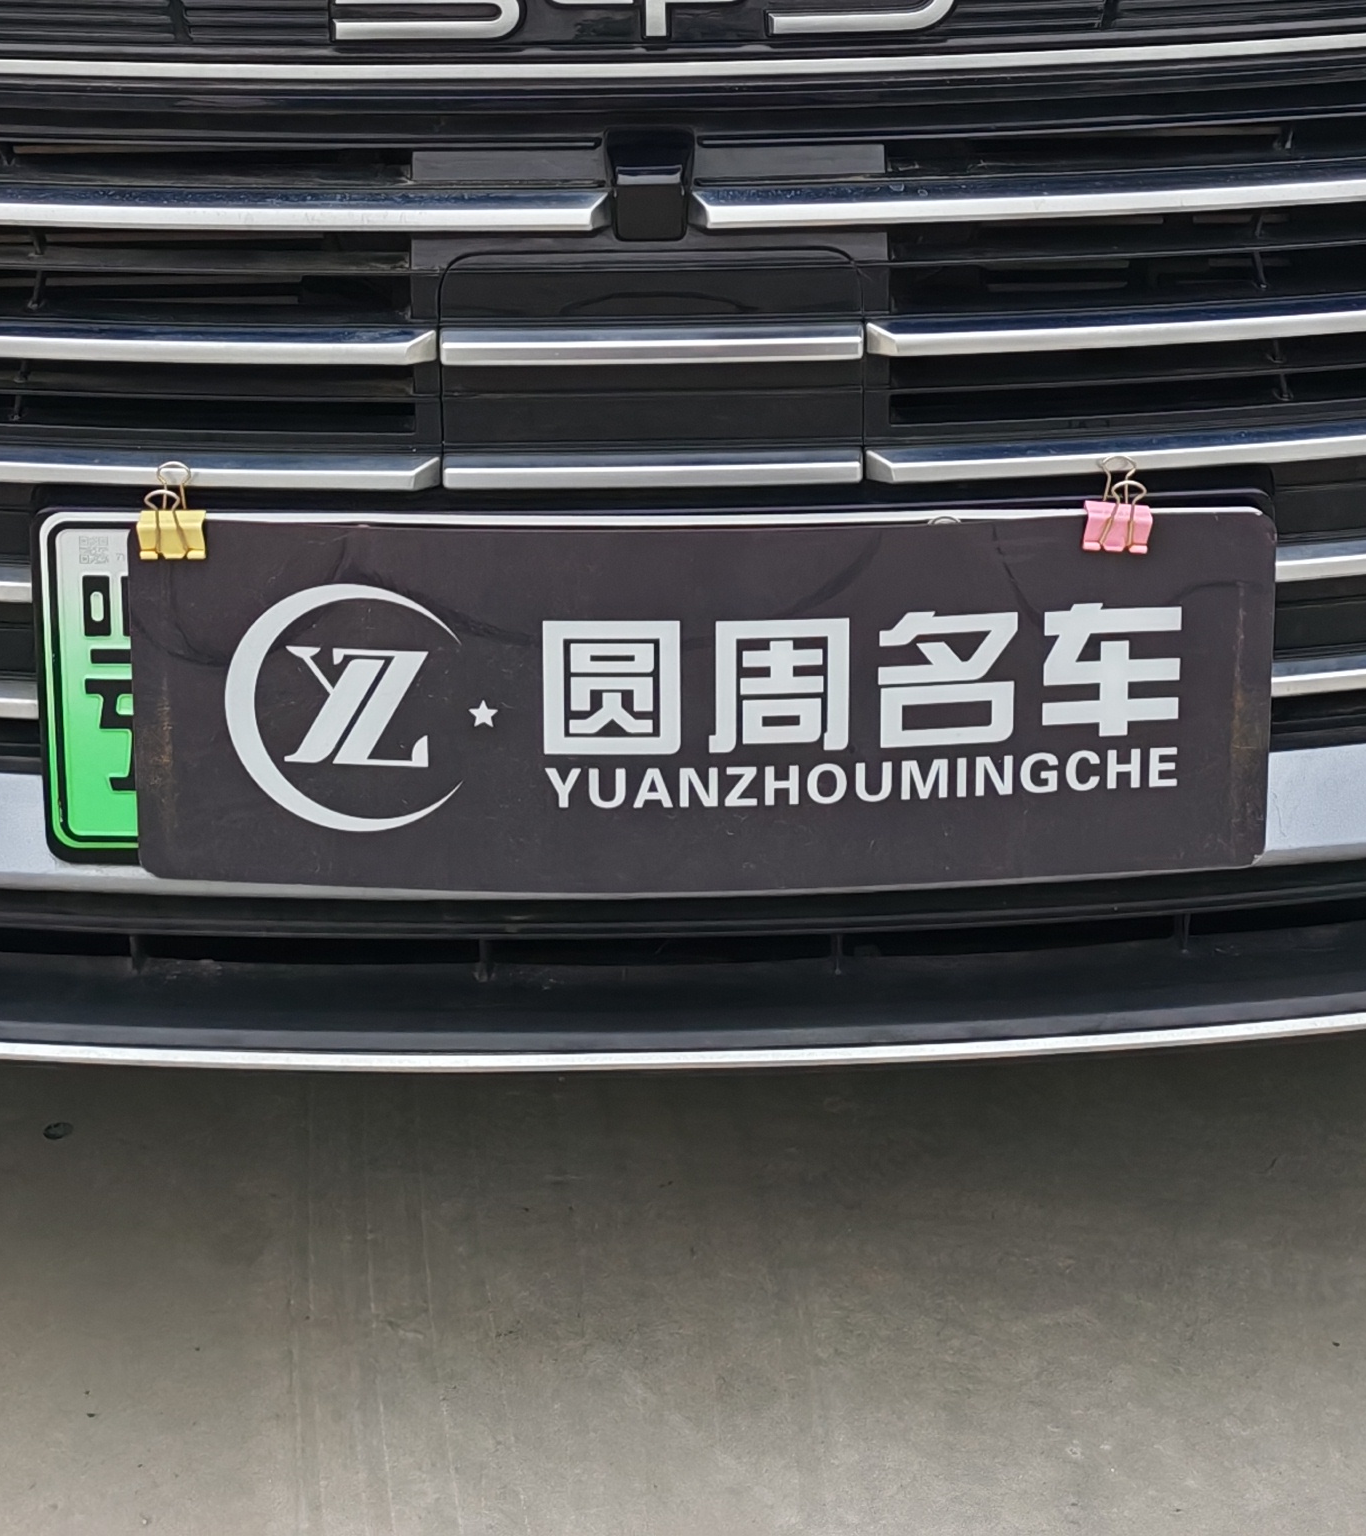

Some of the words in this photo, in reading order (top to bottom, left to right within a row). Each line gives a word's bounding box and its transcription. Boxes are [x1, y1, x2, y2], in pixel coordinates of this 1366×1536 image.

[542, 602, 1182, 755] 圆周名车
[544, 747, 1179, 810] YUANZHOUMINGCHE
